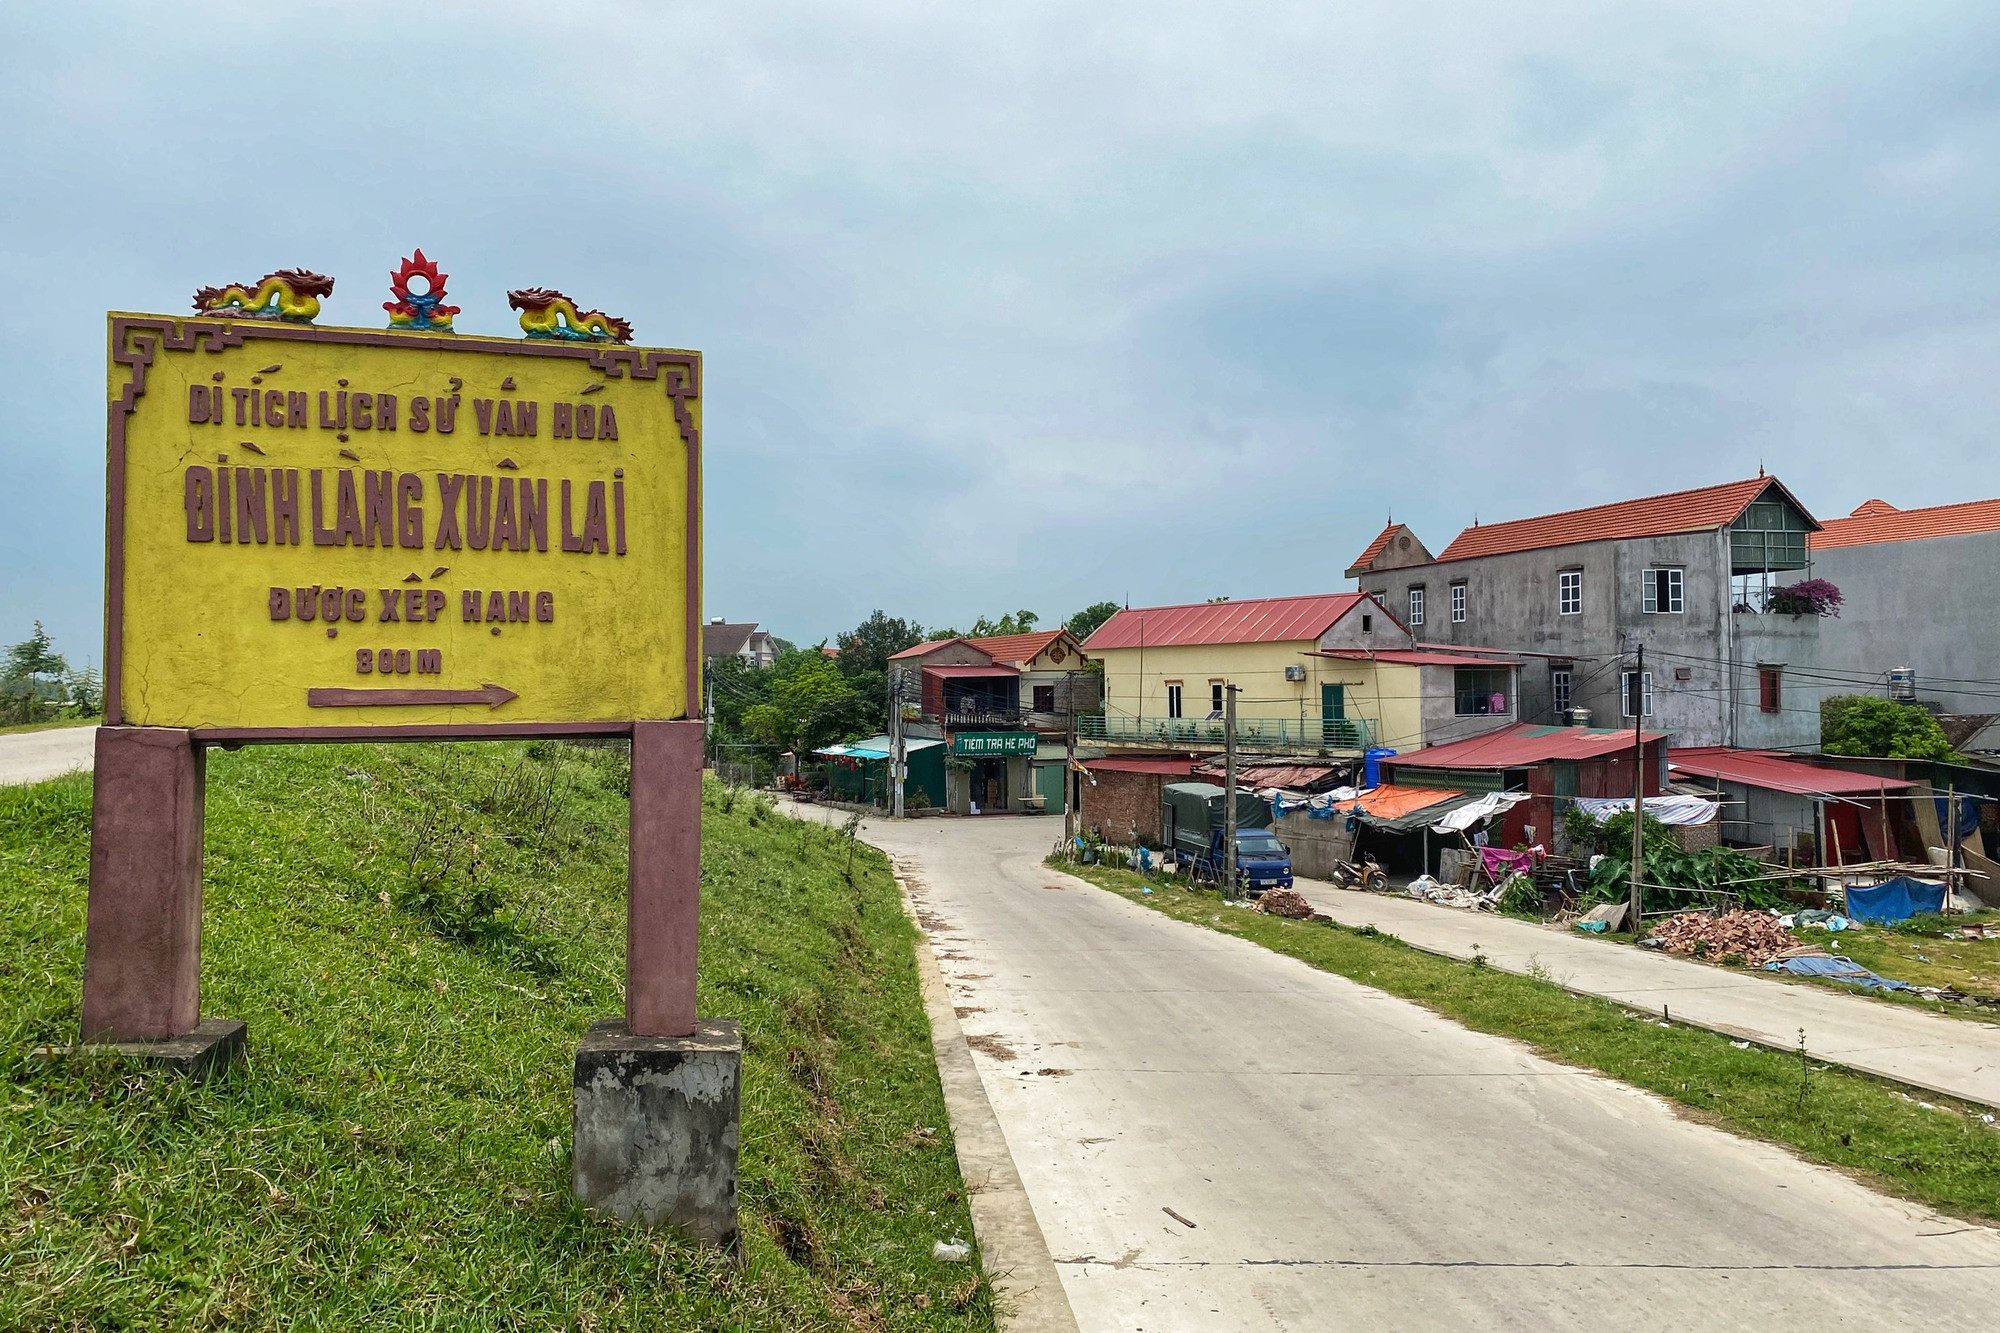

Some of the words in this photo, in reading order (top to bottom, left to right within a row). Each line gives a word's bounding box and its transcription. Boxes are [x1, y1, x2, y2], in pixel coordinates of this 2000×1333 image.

[231, 364, 308, 429] TÍCH
[318, 378, 397, 443] LỊCH
[409, 376, 463, 433] SỬ
[184, 441, 300, 545] ĐÌNH
[310, 449, 424, 549] LÀNG
[434, 457, 548, 553] XUÂN
[269, 584, 365, 639] ĐƯỢC
[379, 566, 450, 623] XẾP
[462, 590, 554, 636] HẠNG
[963, 736, 984, 752] TIỆM
